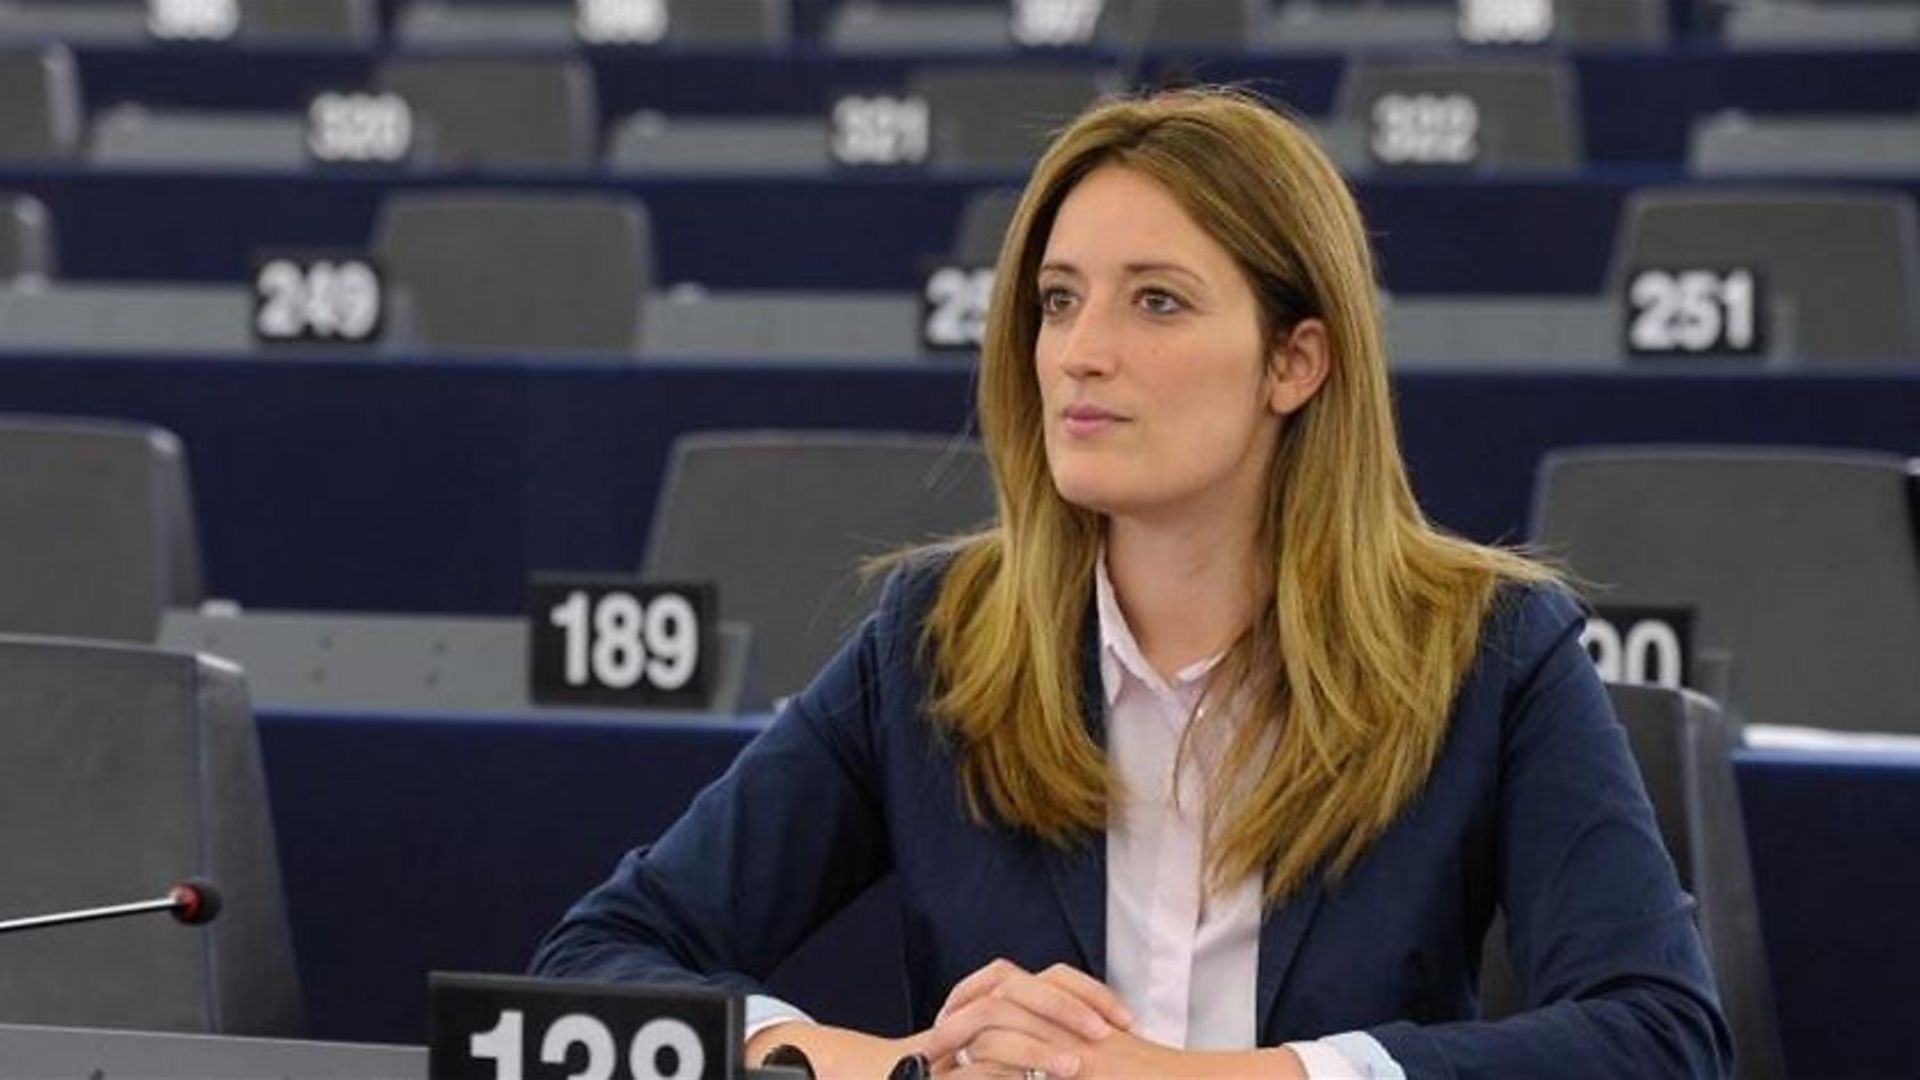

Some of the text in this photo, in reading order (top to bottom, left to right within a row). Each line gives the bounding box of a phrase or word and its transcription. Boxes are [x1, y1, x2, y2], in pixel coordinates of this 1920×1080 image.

[257, 259, 380, 339] 249
[926, 266, 996, 345] 25
[1629, 269, 1754, 351] 251
[549, 590, 699, 690] 189
[1578, 617, 1682, 690] 90
